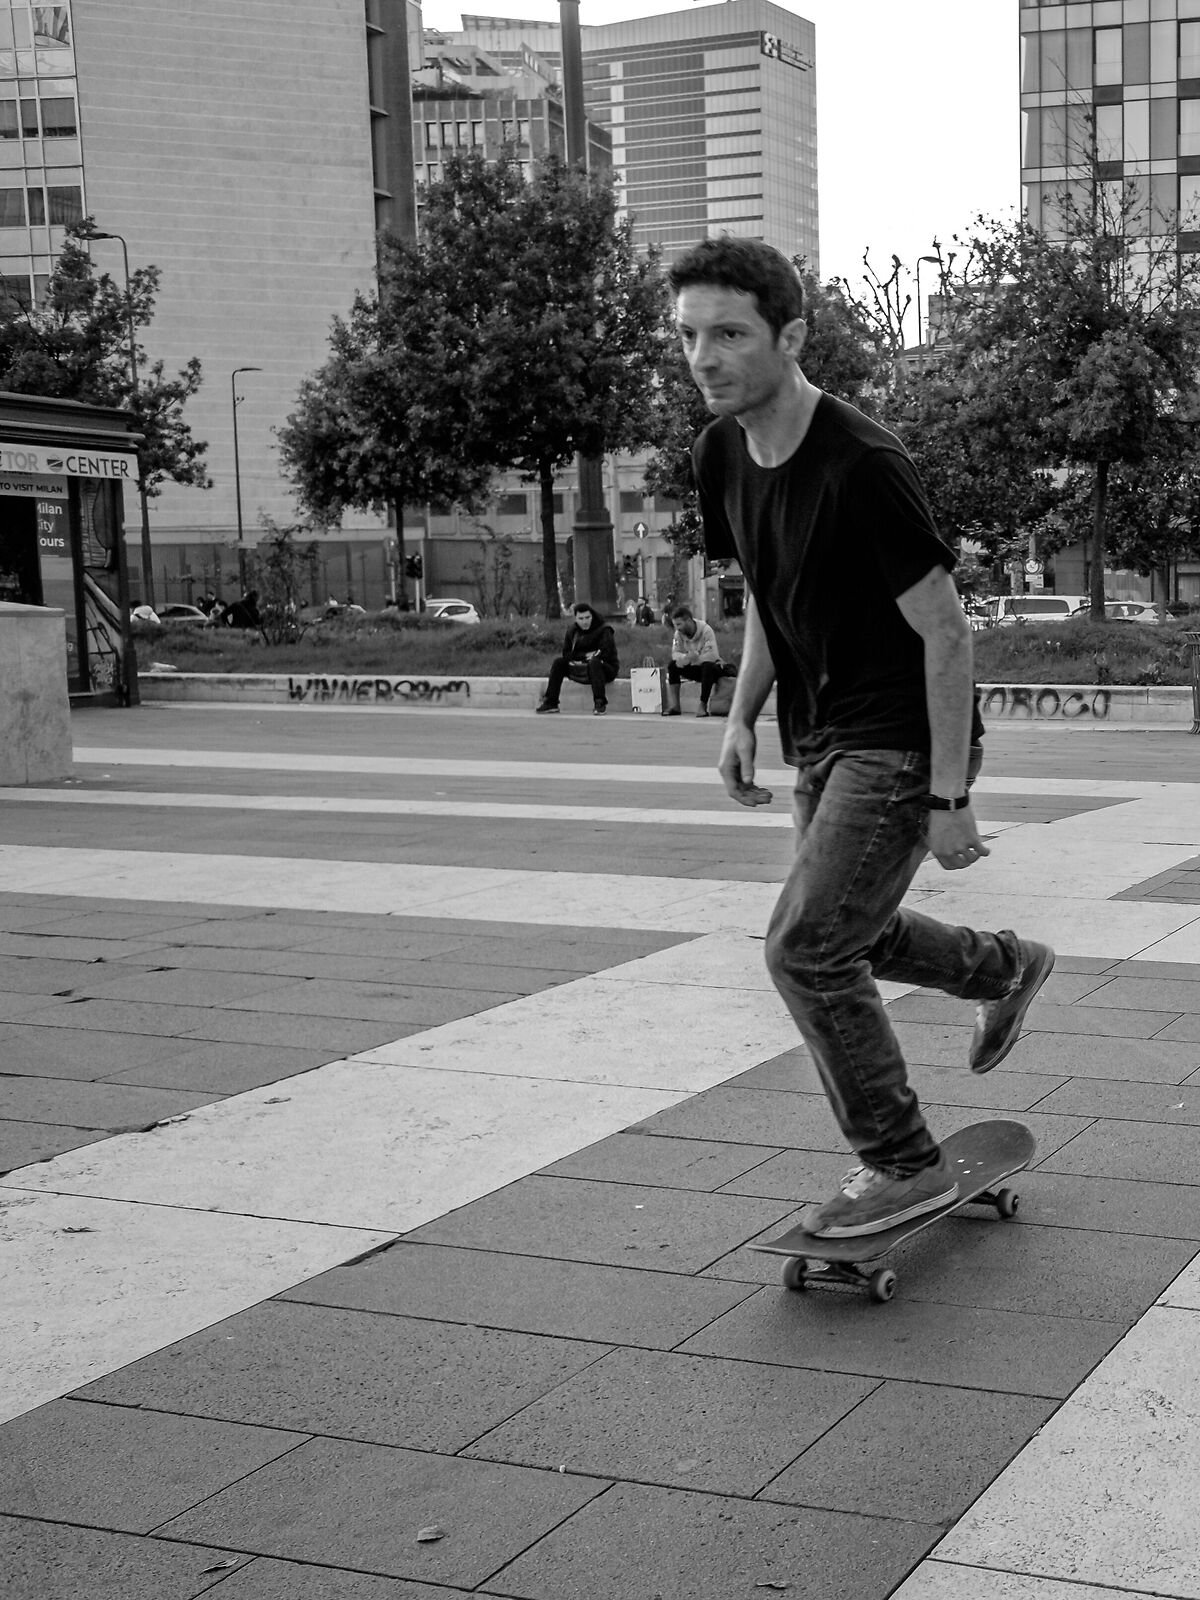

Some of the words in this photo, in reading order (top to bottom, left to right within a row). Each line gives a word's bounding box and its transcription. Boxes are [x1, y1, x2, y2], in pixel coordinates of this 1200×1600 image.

[66, 456, 130, 477] CENTER
[13, 483, 33, 491] VISIT
[36, 485, 63, 493] MILAN
[38, 518, 55, 532] ity
[39, 537, 65, 547] ours
